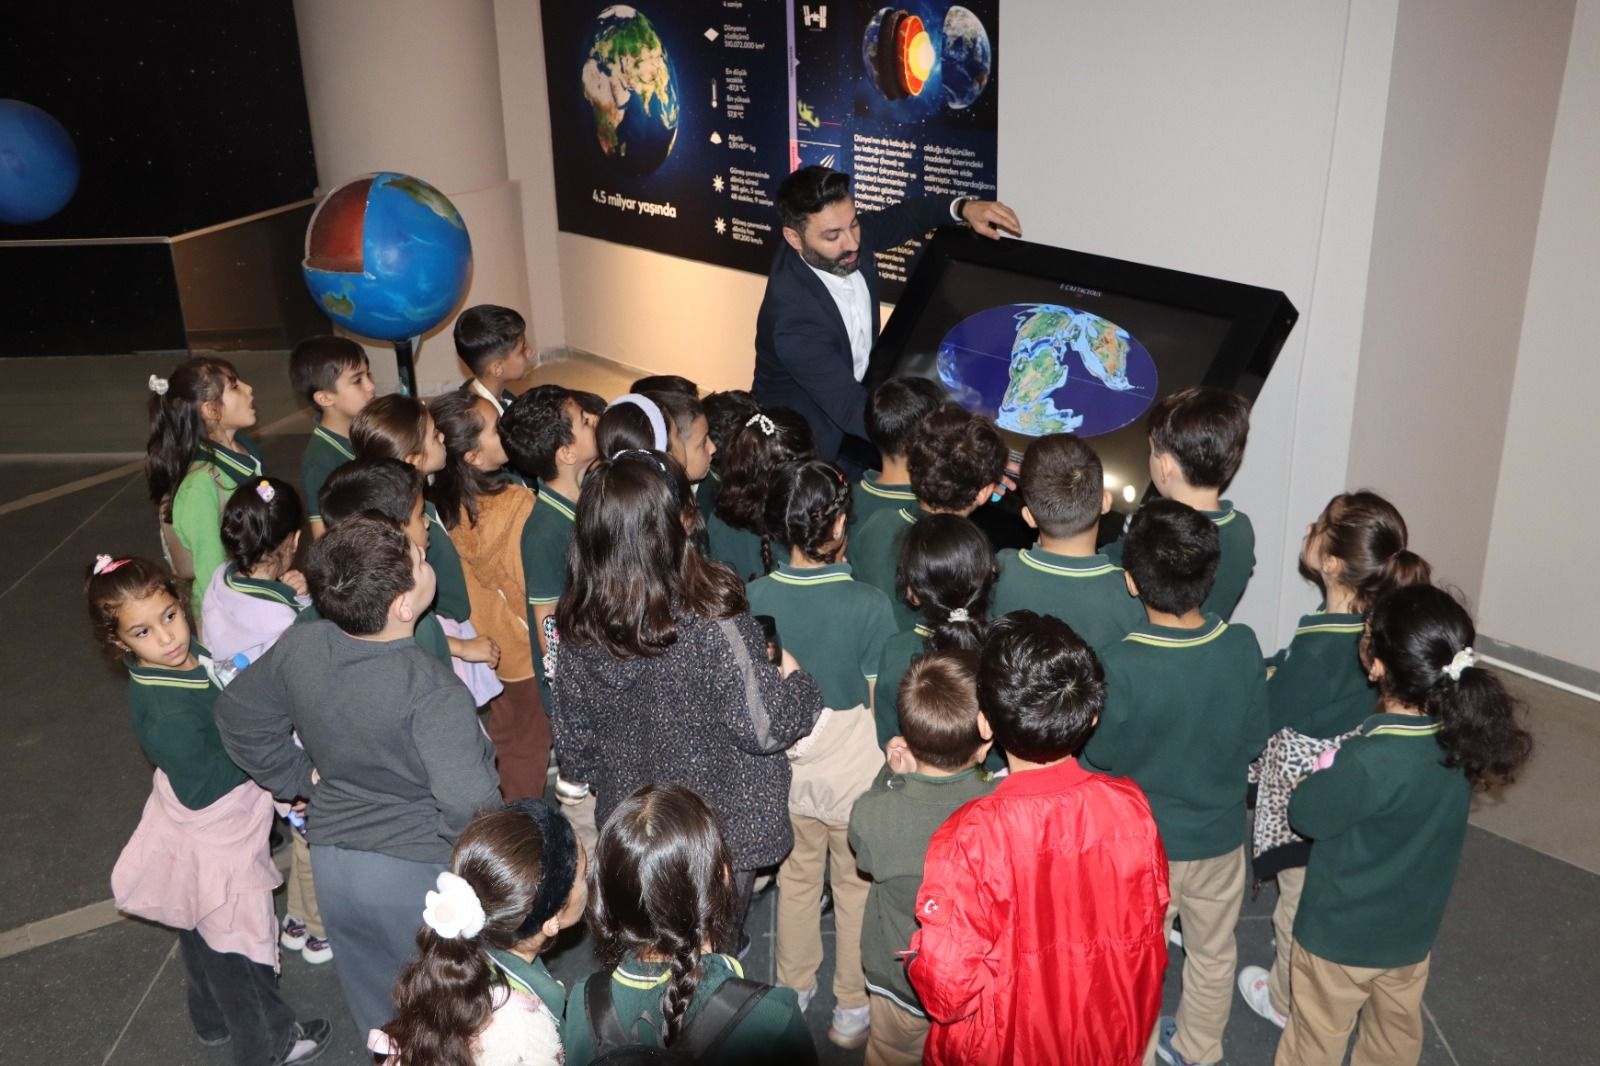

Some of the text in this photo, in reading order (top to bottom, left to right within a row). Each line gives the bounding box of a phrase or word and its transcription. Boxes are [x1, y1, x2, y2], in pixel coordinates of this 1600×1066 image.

[854, 144, 862, 152] bu
[608, 193, 636, 211] milyar
[638, 200, 676, 218] yaşında
